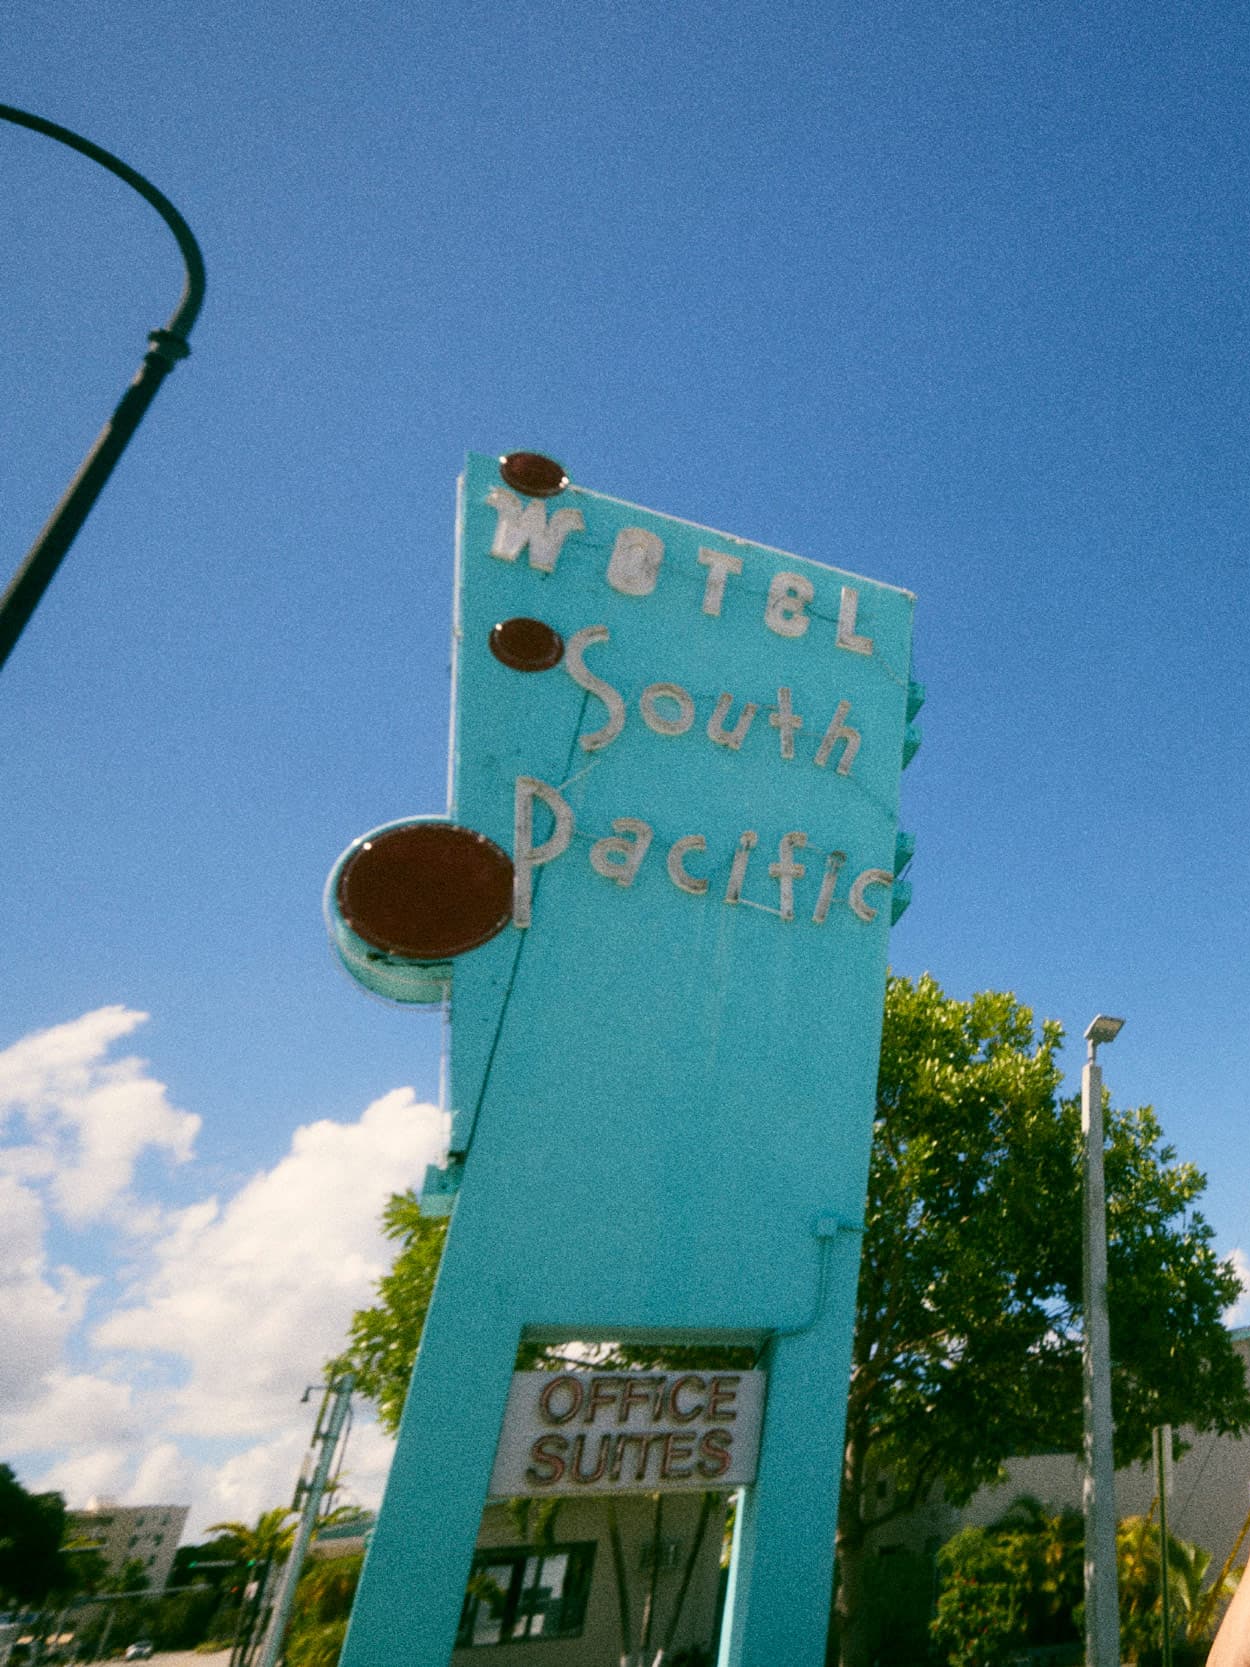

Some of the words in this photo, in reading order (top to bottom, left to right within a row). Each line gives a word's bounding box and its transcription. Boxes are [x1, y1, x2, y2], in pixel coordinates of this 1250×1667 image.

[565, 624, 862, 777] South
[512, 775, 895, 929] Pacific
[539, 1374, 741, 1426] OFFICE
[525, 1427, 734, 1487] SUITES
